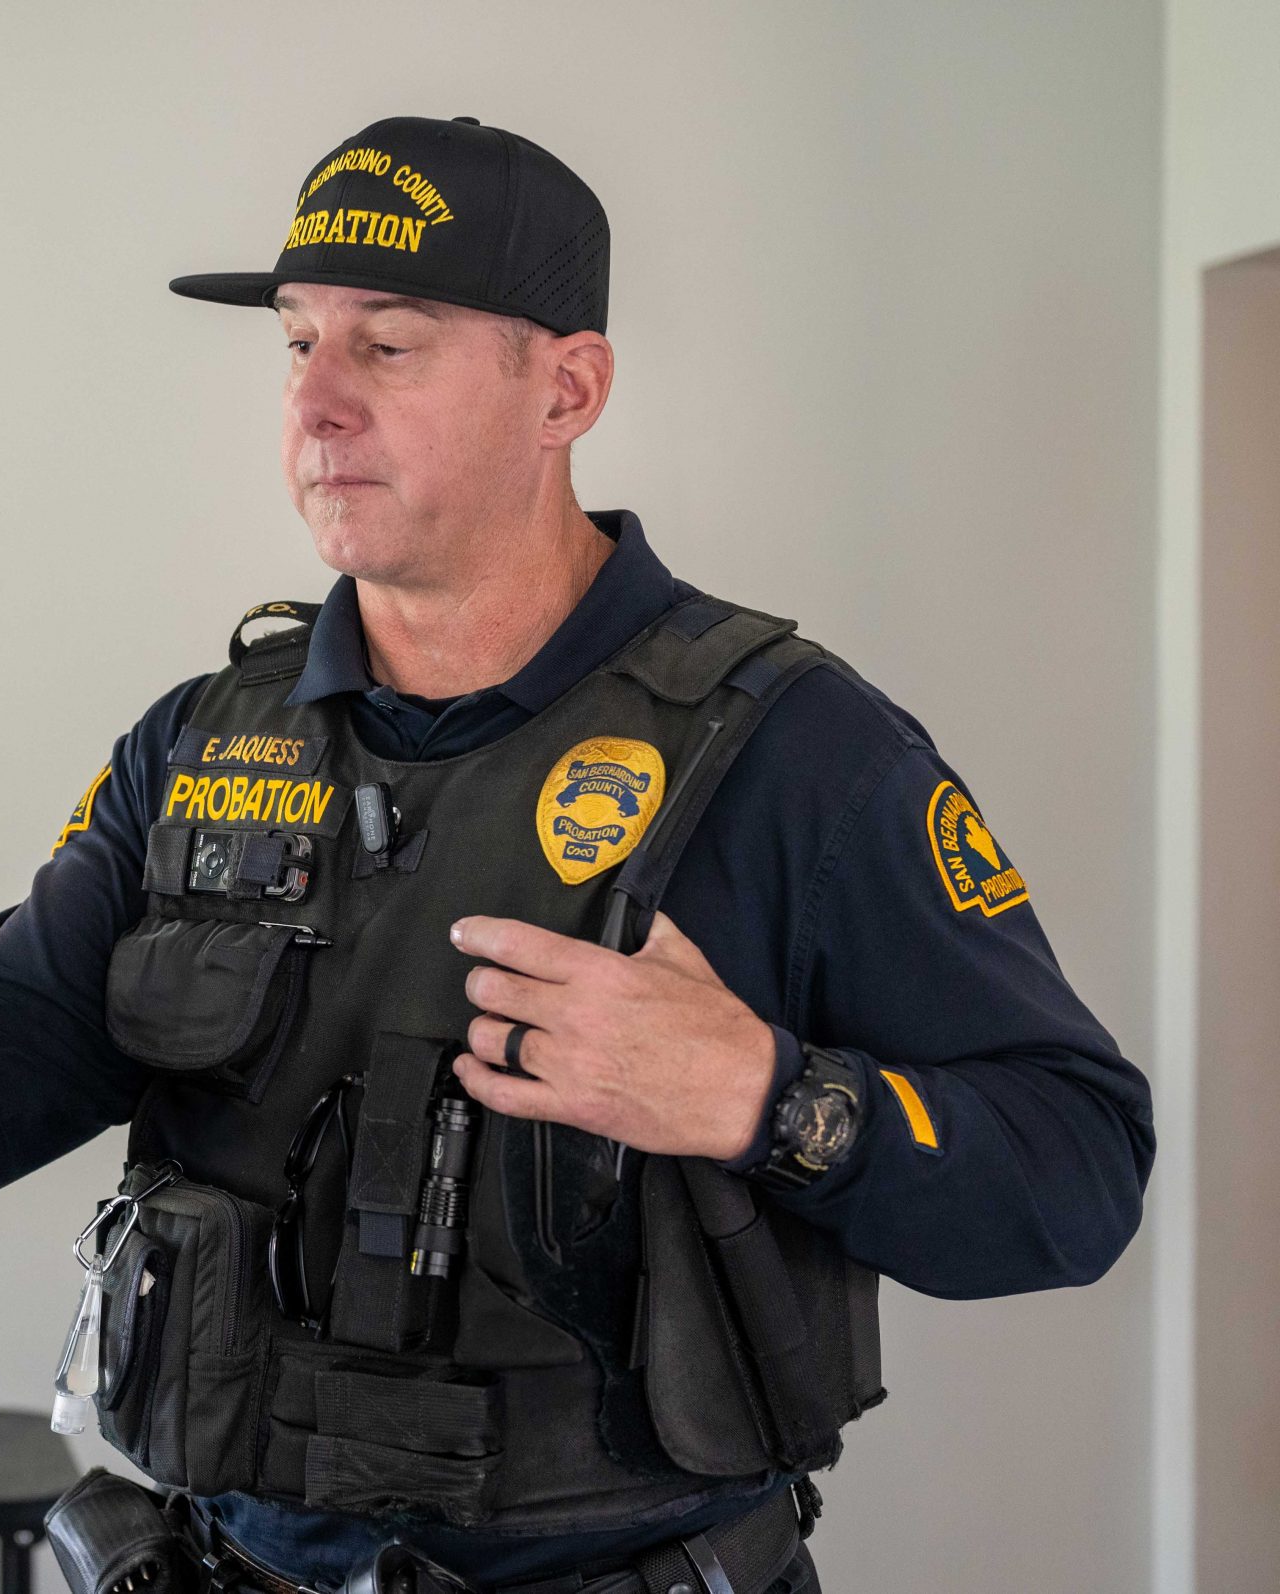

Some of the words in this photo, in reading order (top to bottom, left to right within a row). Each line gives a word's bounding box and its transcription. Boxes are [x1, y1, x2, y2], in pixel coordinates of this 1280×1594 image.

[307, 148, 392, 198] BERNARDINO
[393, 165, 454, 226] COUNTY
[568, 767, 589, 779] SAN
[589, 765, 646, 791] BERNARDINO
[579, 781, 626, 799] COUNTY
[166, 774, 335, 824] PROBATION
[558, 819, 619, 840] PROBATION
[947, 856, 975, 893] SAN
